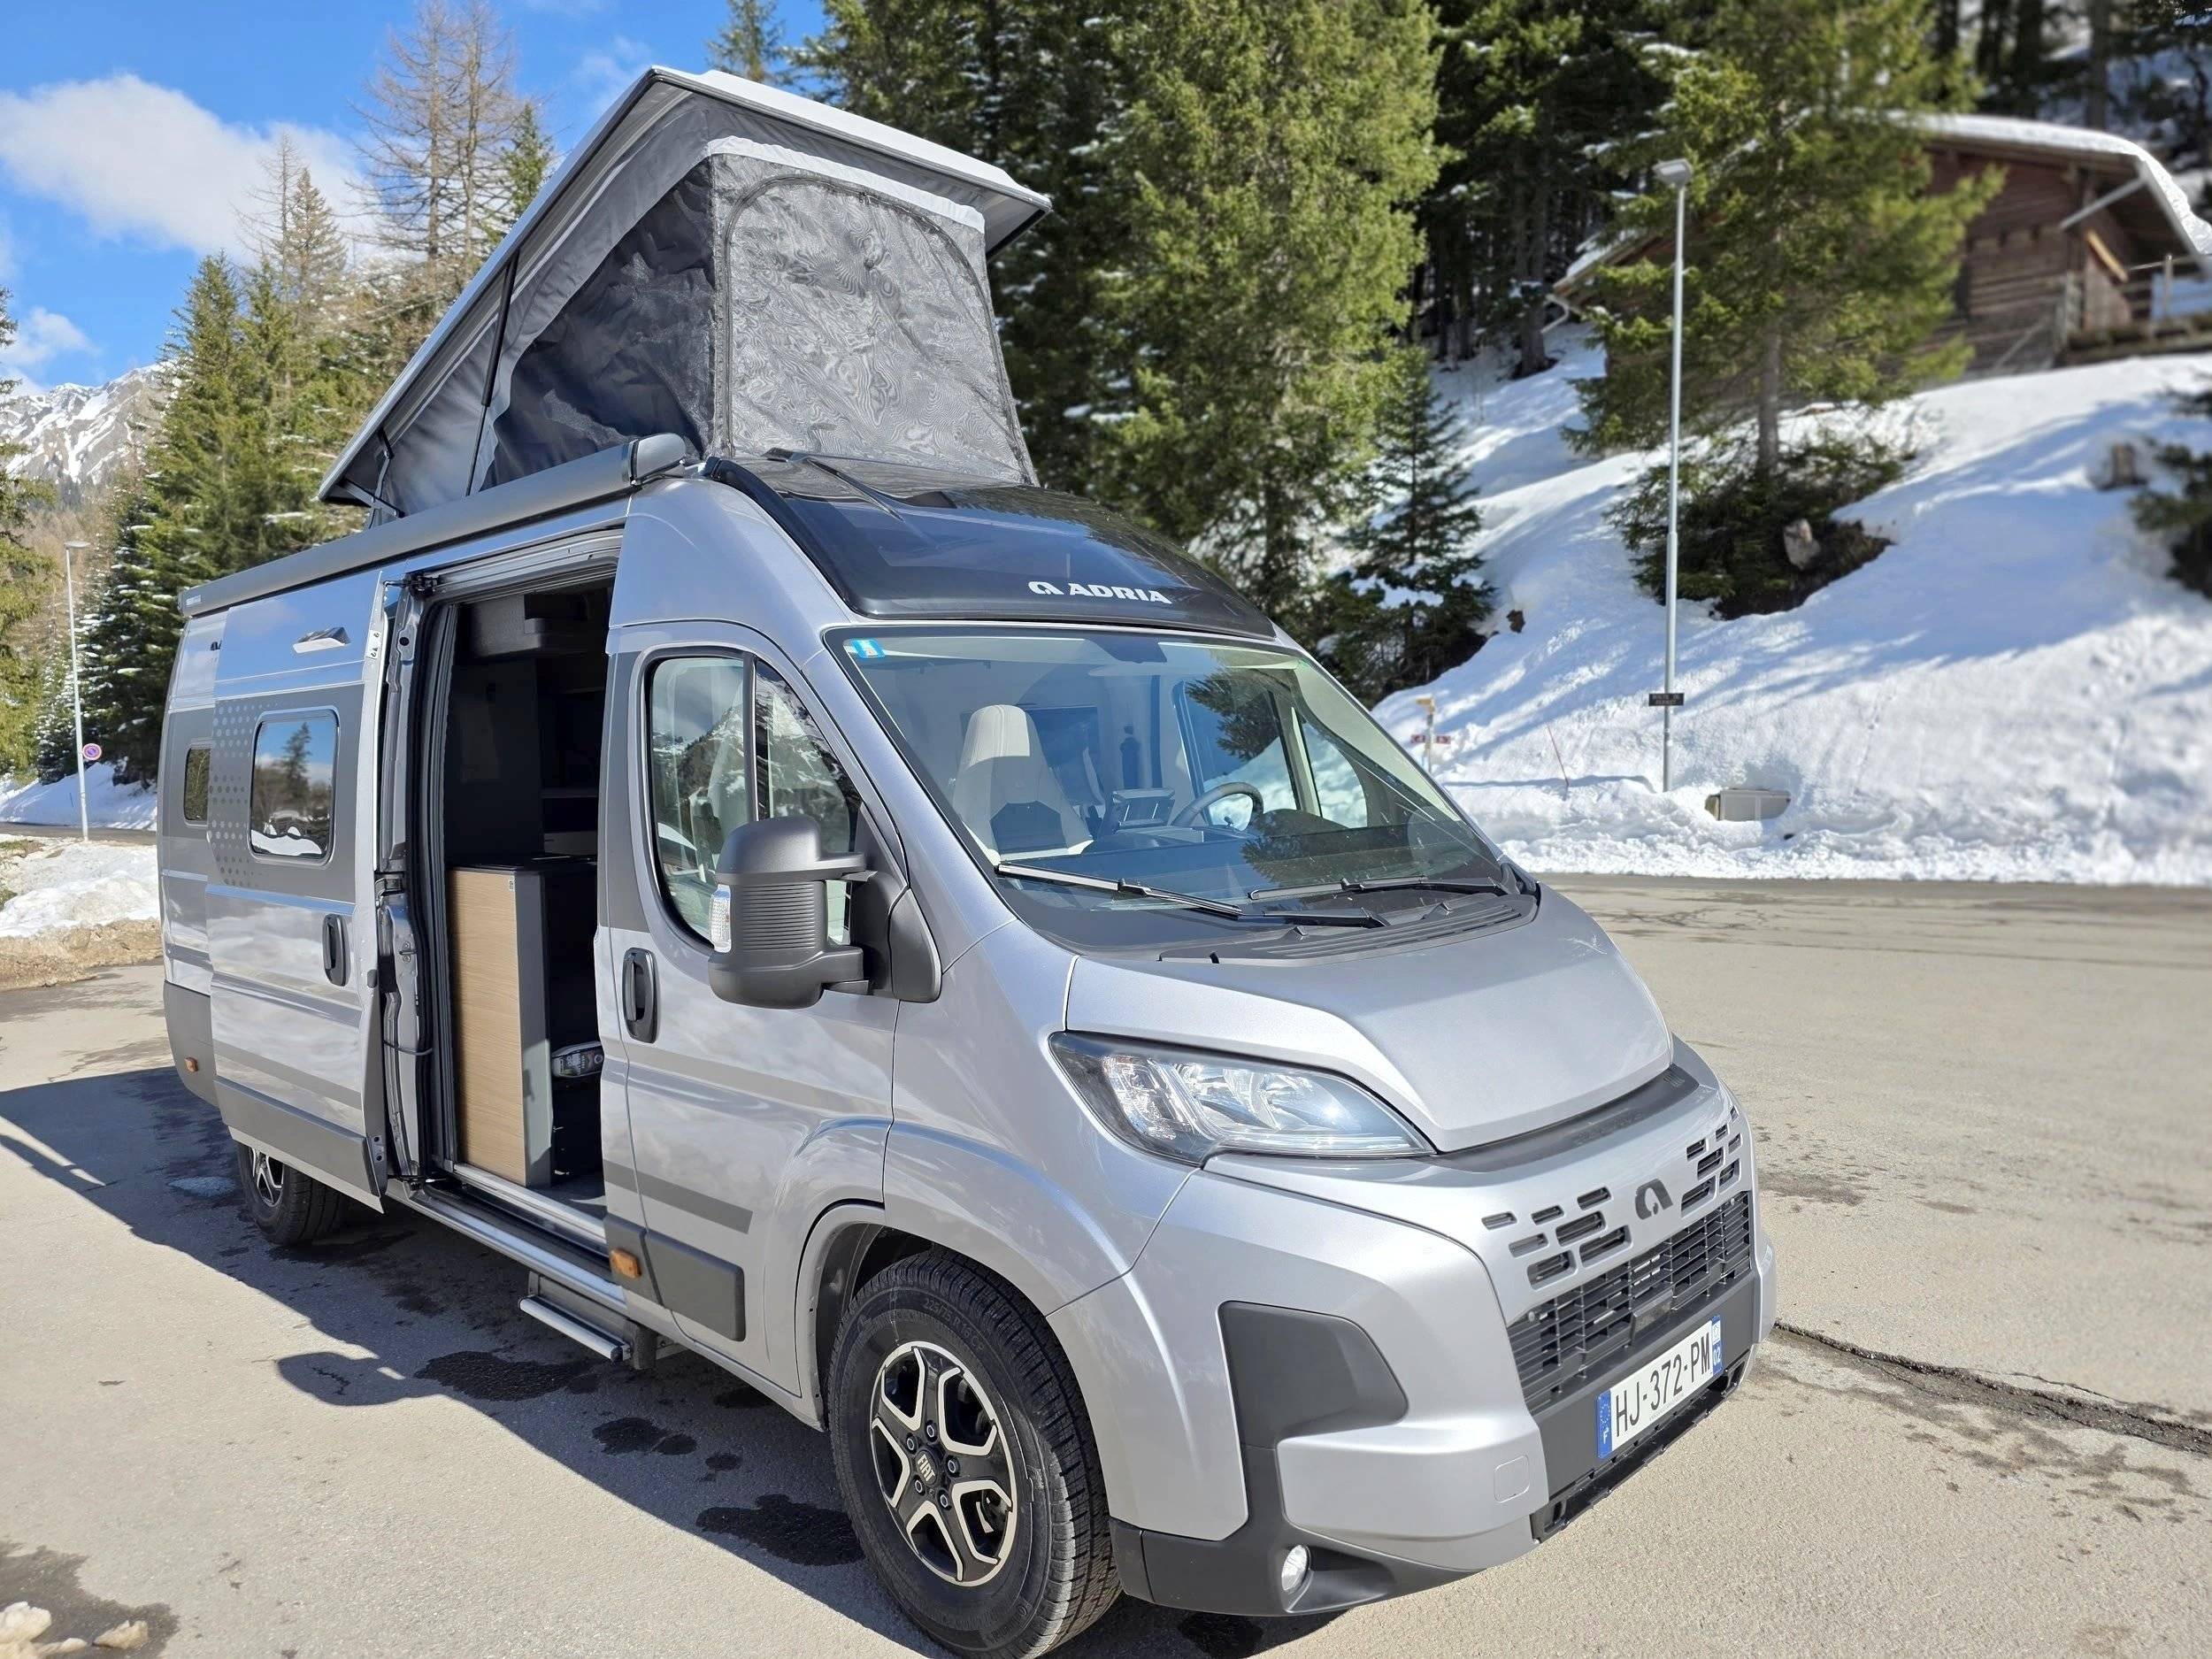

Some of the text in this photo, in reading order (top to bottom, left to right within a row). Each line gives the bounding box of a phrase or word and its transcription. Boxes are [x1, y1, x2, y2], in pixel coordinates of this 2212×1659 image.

[1068, 582, 1173, 604] ADRIA
[1713, 1346, 1721, 1366] 02
[1616, 1332, 1711, 1438] HJ-372-PM
[1602, 1426, 1609, 1445] F
[917, 1454, 936, 1482] FIAT
